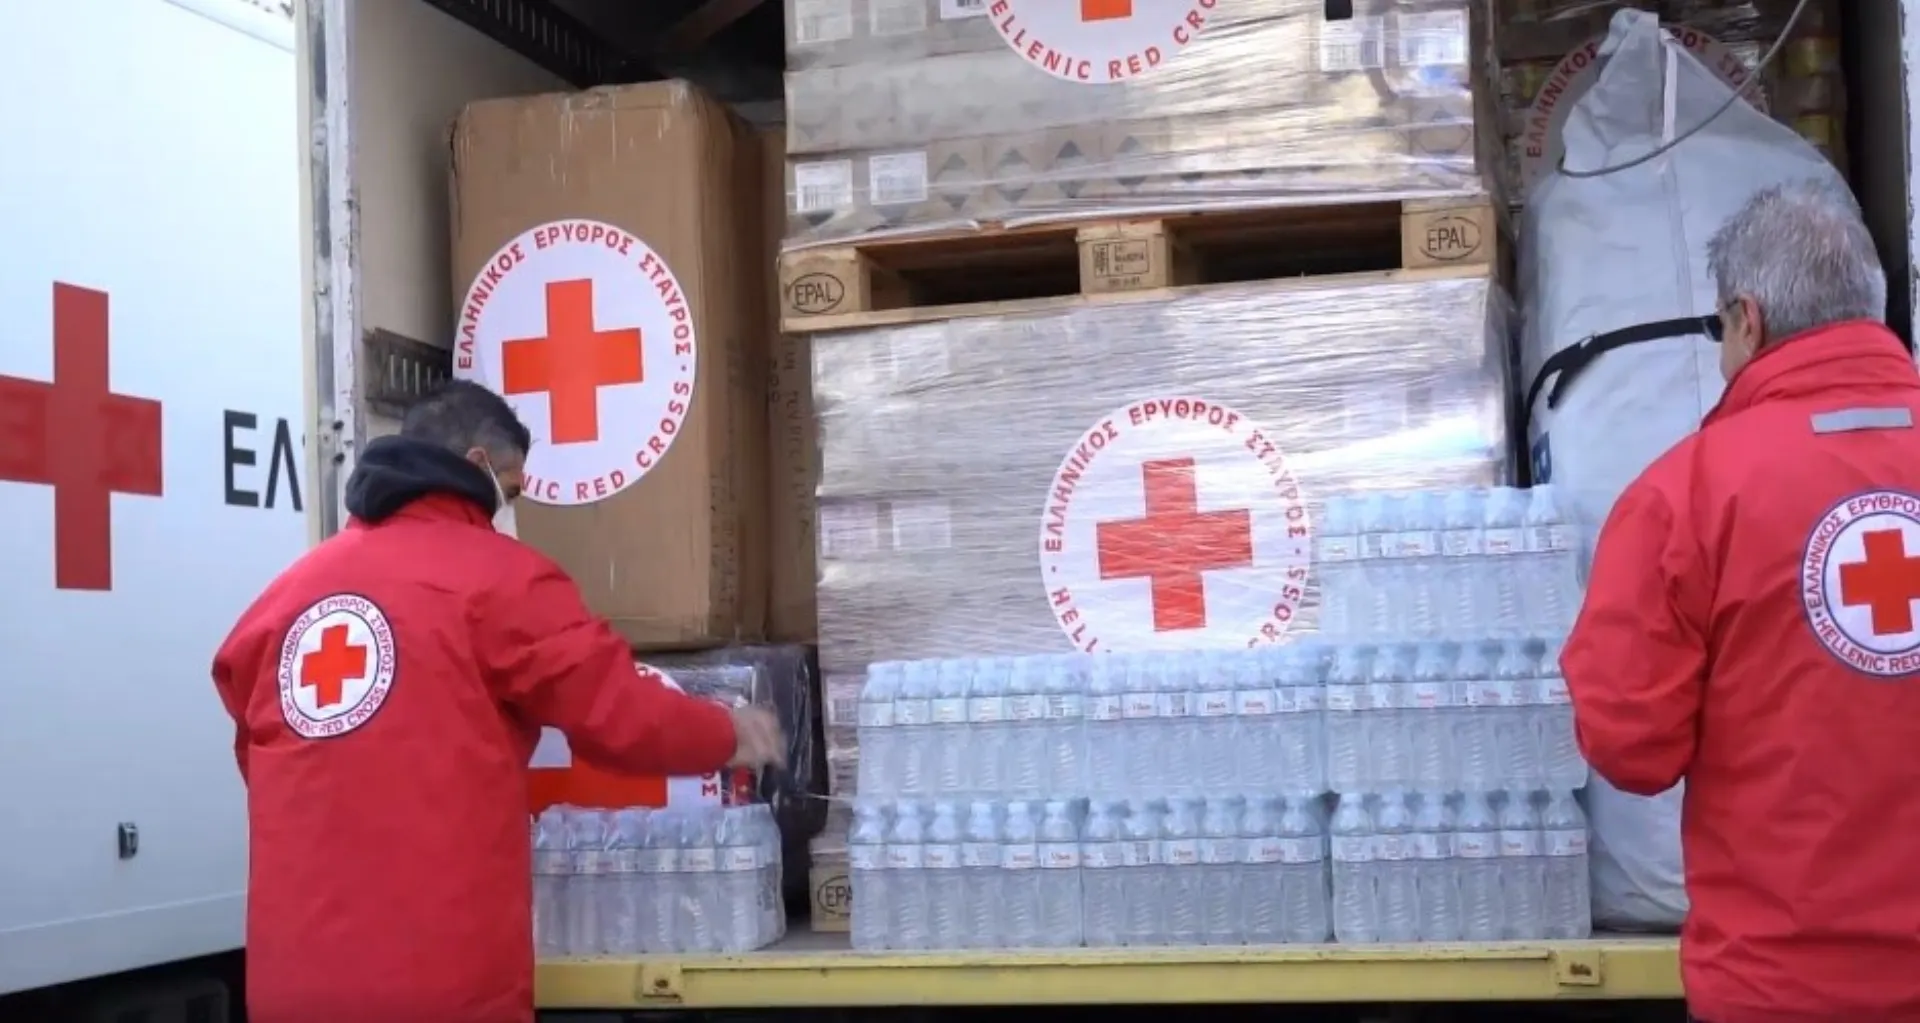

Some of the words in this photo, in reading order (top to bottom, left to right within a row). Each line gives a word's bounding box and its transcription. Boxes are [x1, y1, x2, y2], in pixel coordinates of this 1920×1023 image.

[991, 0, 1091, 79] ELLENIC
[1108, 46, 1161, 79] RED
[1173, 0, 1216, 45] CRO
[1427, 226, 1472, 250] EPAL
[458, 243, 525, 369] ΕΛΛΗΝΙΚΟΣ
[533, 223, 634, 255] ΕΡΥΘΡΟΣ
[638, 253, 691, 356] ΣΤΑΥΡΟΣ
[795, 283, 836, 306] EPAL
[224, 409, 304, 512] ΕΛ
[575, 470, 625, 500] RED
[636, 381, 689, 468] CROSS
[1045, 421, 1118, 552] ΕΛΛΗΝΙΚΟΣ
[1128, 399, 1239, 433] ΕΡΥΘΡΟΣ
[1805, 512, 1845, 610] ΕΛΛΗΝΙΚΟΣ
[1815, 617, 1885, 671] HELLENIC
[347, 686, 385, 727] CROSS
